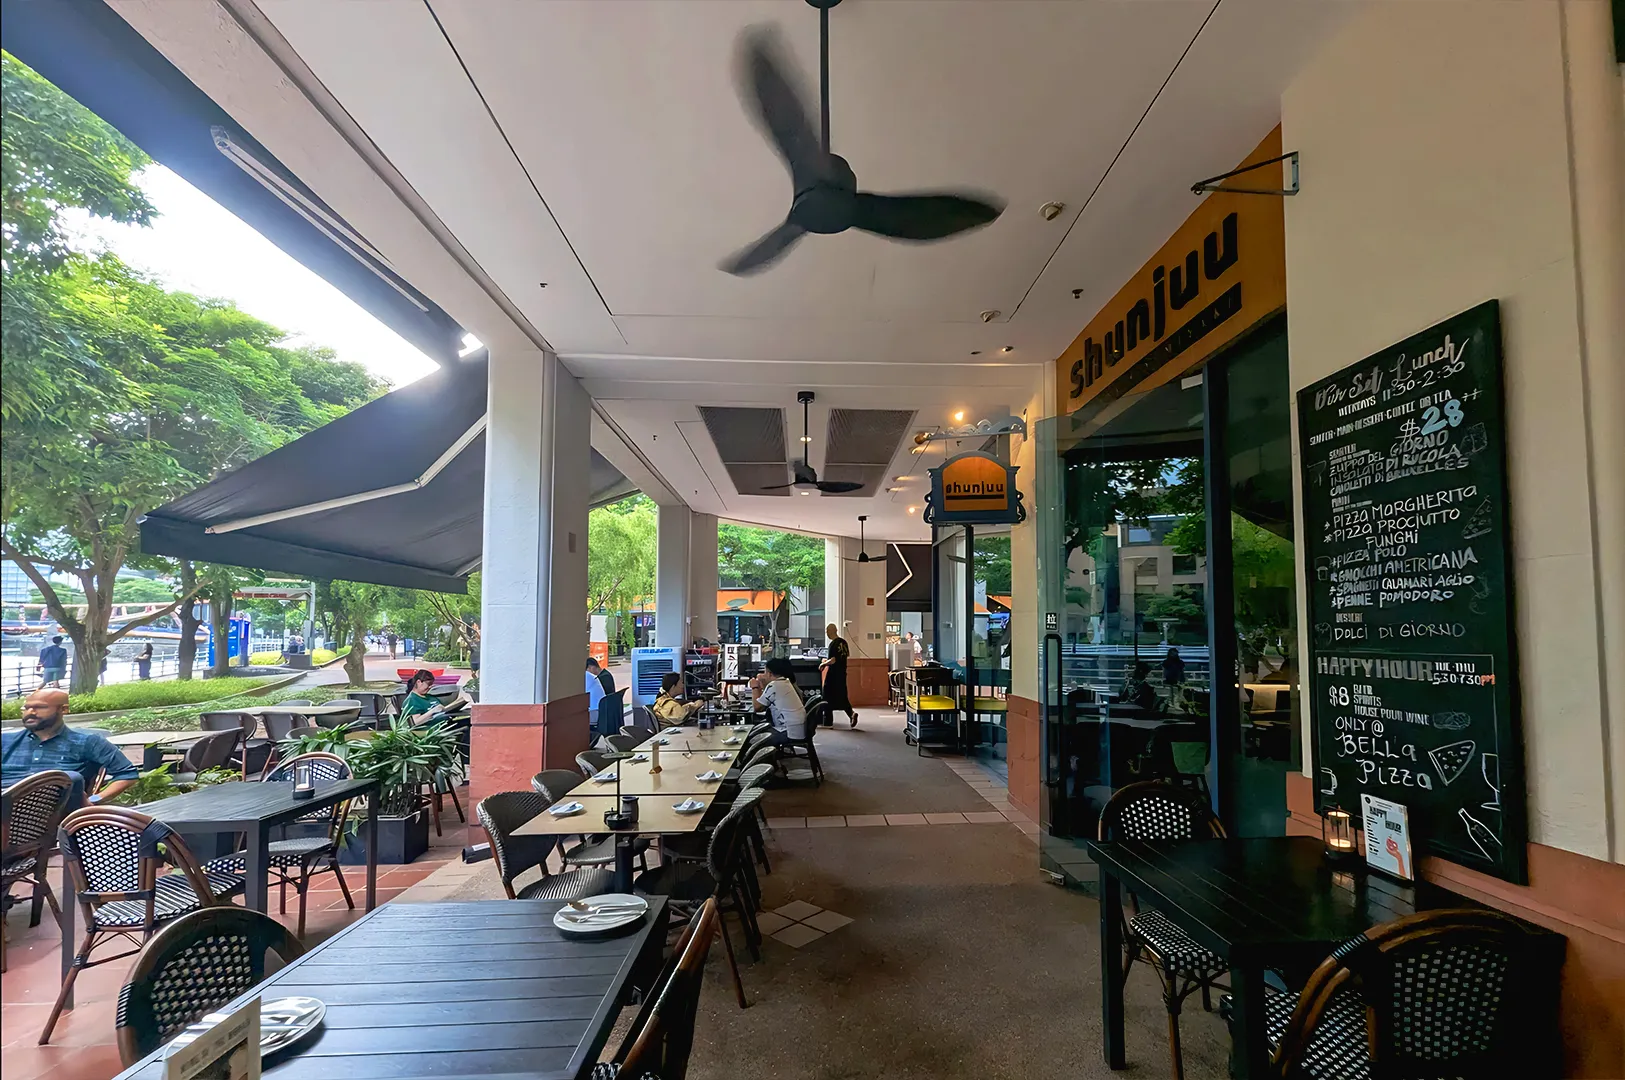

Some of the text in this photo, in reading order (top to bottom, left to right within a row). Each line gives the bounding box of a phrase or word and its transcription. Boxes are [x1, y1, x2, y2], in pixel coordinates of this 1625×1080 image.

[1070, 212, 1238, 399] shunjuu
[1349, 366, 1383, 398] Set
[1389, 334, 1469, 386] Lunch
[1368, 451, 1385, 463] DEL
[1386, 457, 1398, 472] DI
[1402, 444, 1463, 466] RUCOLA
[946, 481, 1004, 495] shunjuu
[1374, 544, 1406, 562] POLO
[1379, 589, 1454, 608] POMODORO
[1317, 656, 1433, 681] HAPPY HOUR
[1328, 685, 1350, 707] $8
[1335, 716, 1384, 737] ONLY @
[1405, 711, 1430, 726] WINE
